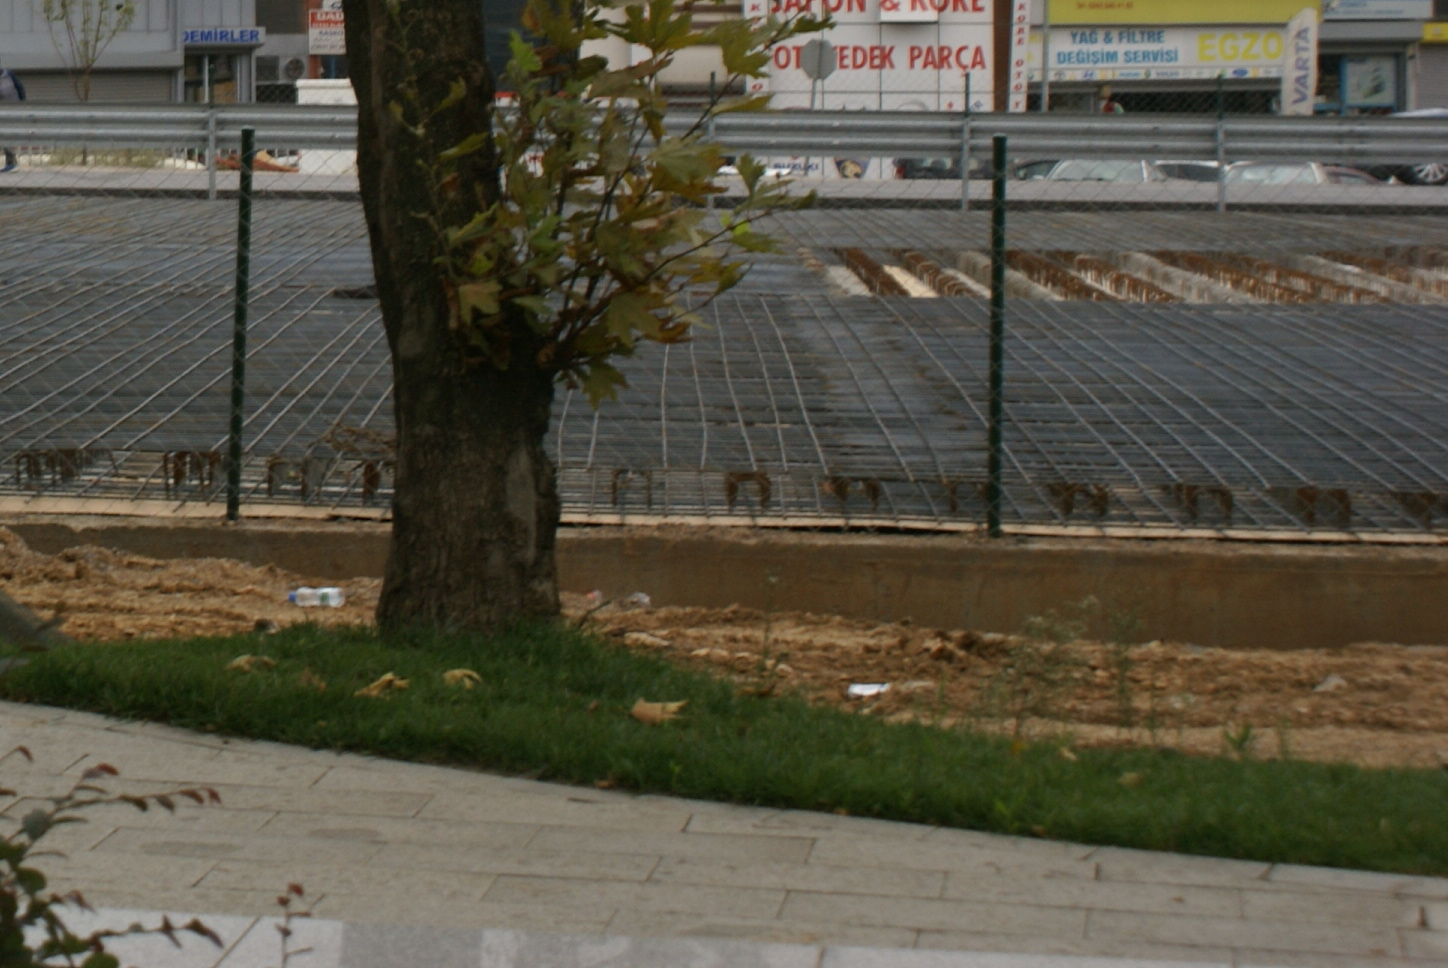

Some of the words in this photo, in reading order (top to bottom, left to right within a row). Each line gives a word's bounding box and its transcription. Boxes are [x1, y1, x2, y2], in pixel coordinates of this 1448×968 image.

[1070, 28, 1099, 45] YAĞ
[1103, 30, 1114, 44] &
[1118, 28, 1165, 44] FİLTRE
[774, 44, 896, 70] OTEDEK
[907, 44, 987, 78] PARÇA
[1057, 46, 1119, 65] DEĞİŞİM
[1123, 46, 1179, 63] SERVİSİ
[1291, 26, 1310, 106] VARTA
